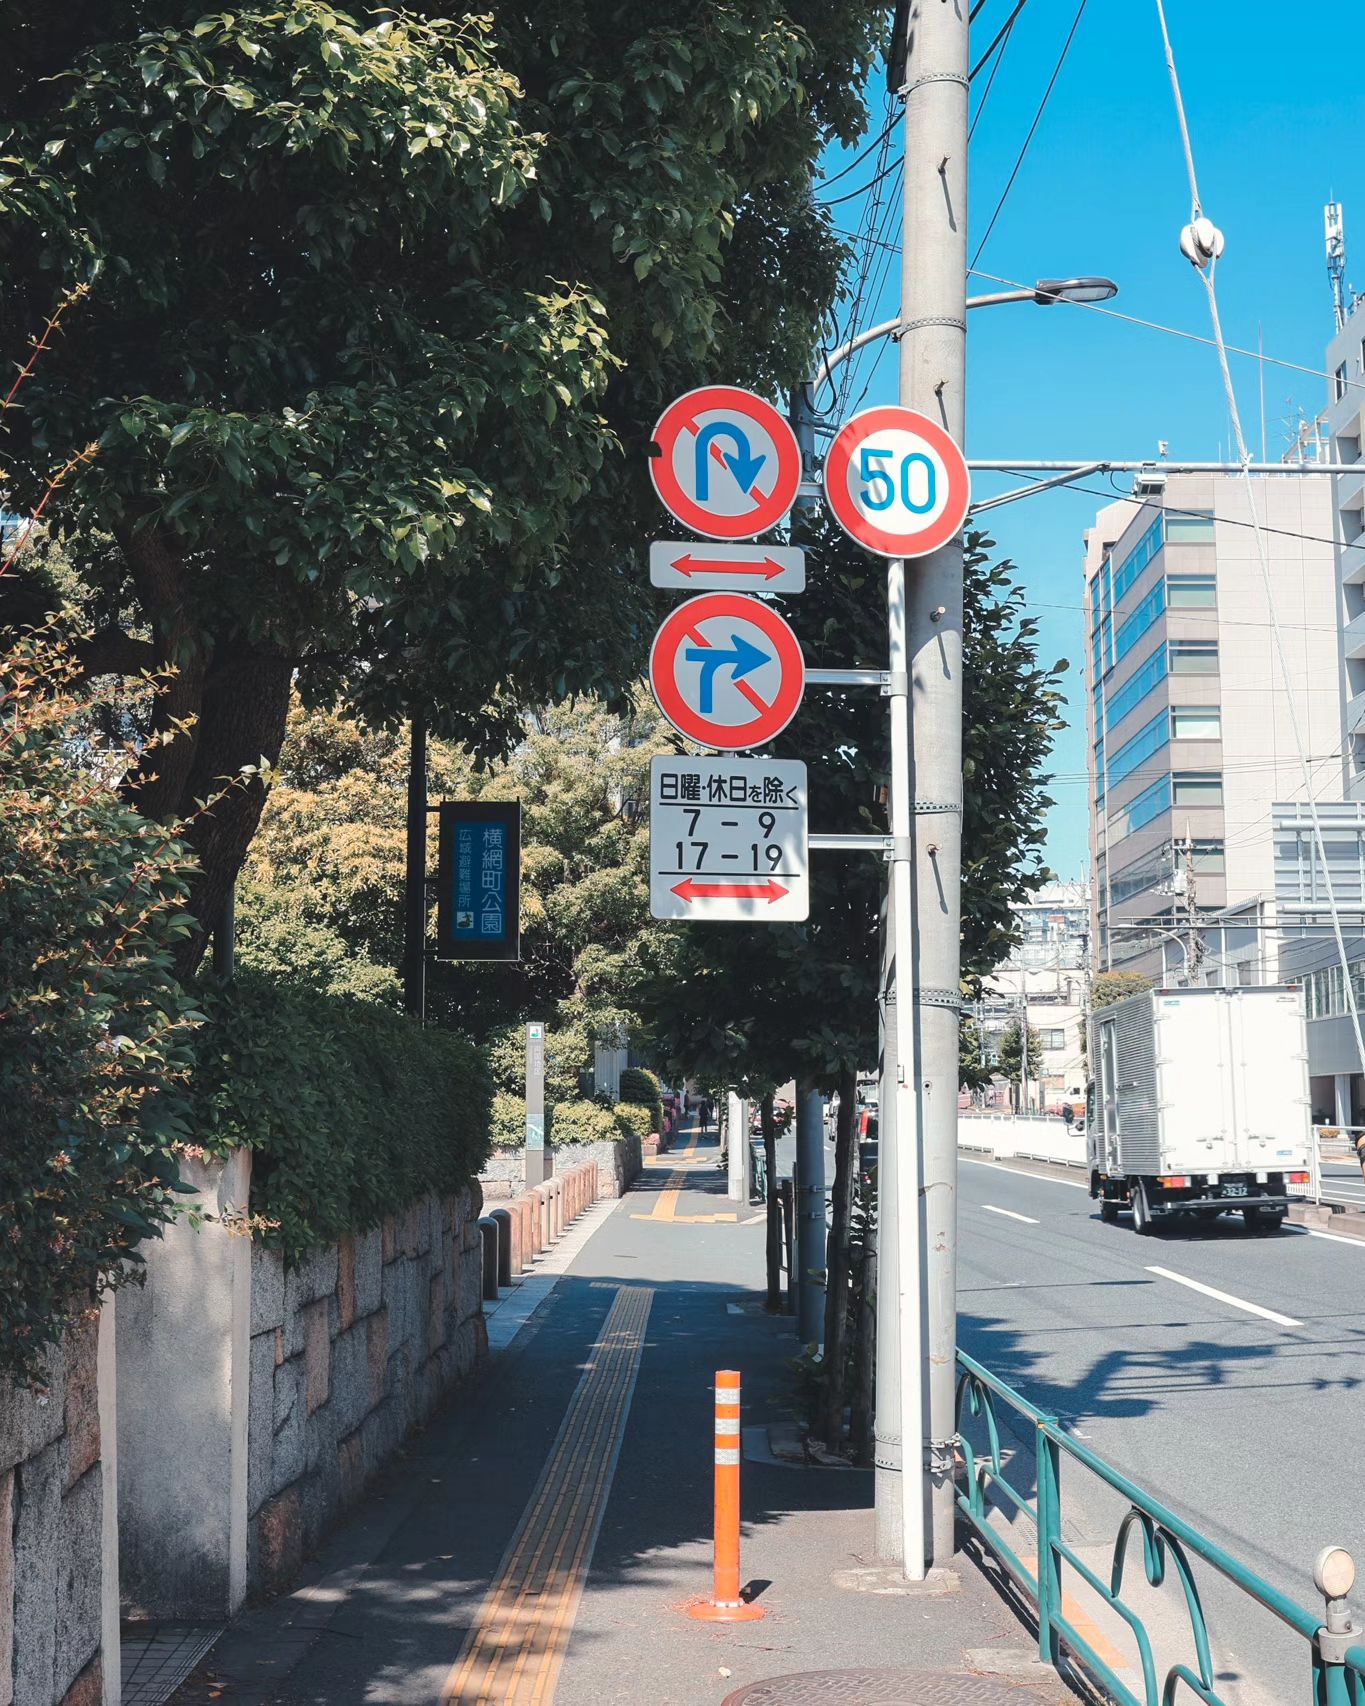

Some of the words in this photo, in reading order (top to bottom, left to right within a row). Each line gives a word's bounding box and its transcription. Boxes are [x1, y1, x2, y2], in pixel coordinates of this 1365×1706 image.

[860, 447, 936, 515] 50
[660, 773, 798, 805] 日曜・休日を除く
[683, 808, 701, 837] 7
[758, 811, 776, 839] 9
[676, 841, 709, 870] 17
[751, 843, 783, 872] 19
[481, 828, 503, 934] 横網町公園
